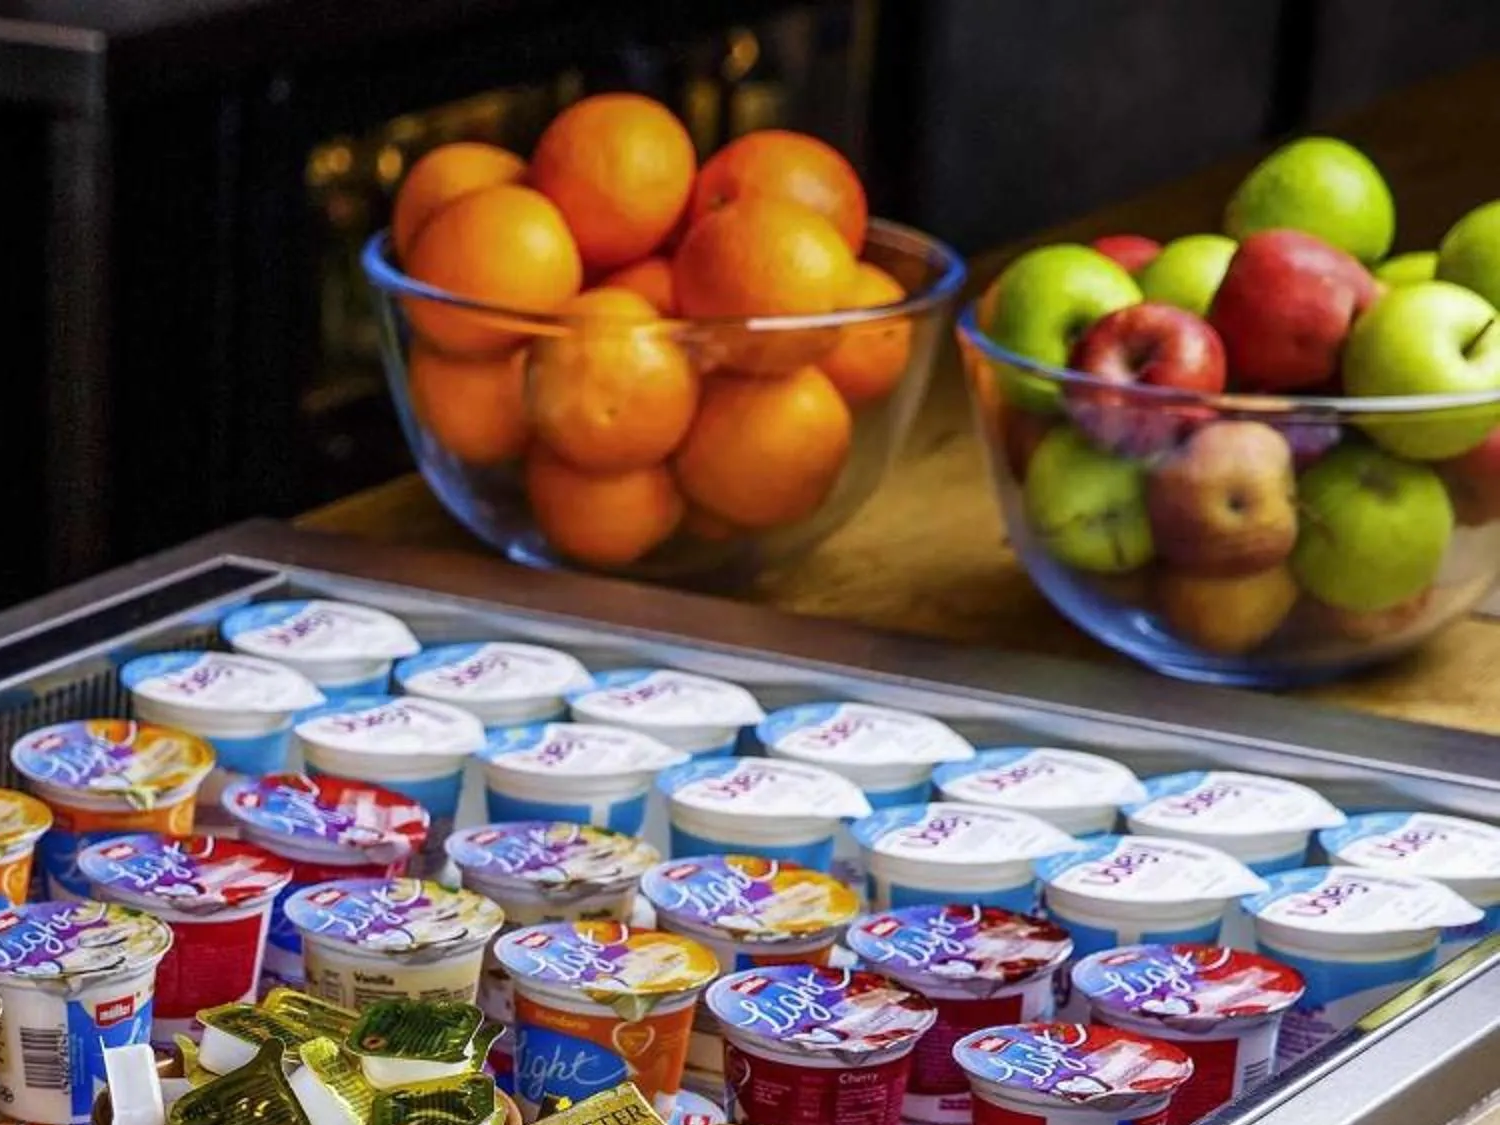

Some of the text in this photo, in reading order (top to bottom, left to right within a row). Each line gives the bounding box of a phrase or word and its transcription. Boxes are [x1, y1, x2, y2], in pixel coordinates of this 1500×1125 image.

[522, 923, 628, 980] Light
[875, 904, 981, 966] Light
[737, 967, 850, 1034] Light
[1091, 946, 1230, 1002] Light
[839, 1072, 879, 1086] Cherry
[989, 1024, 1087, 1085] Light
